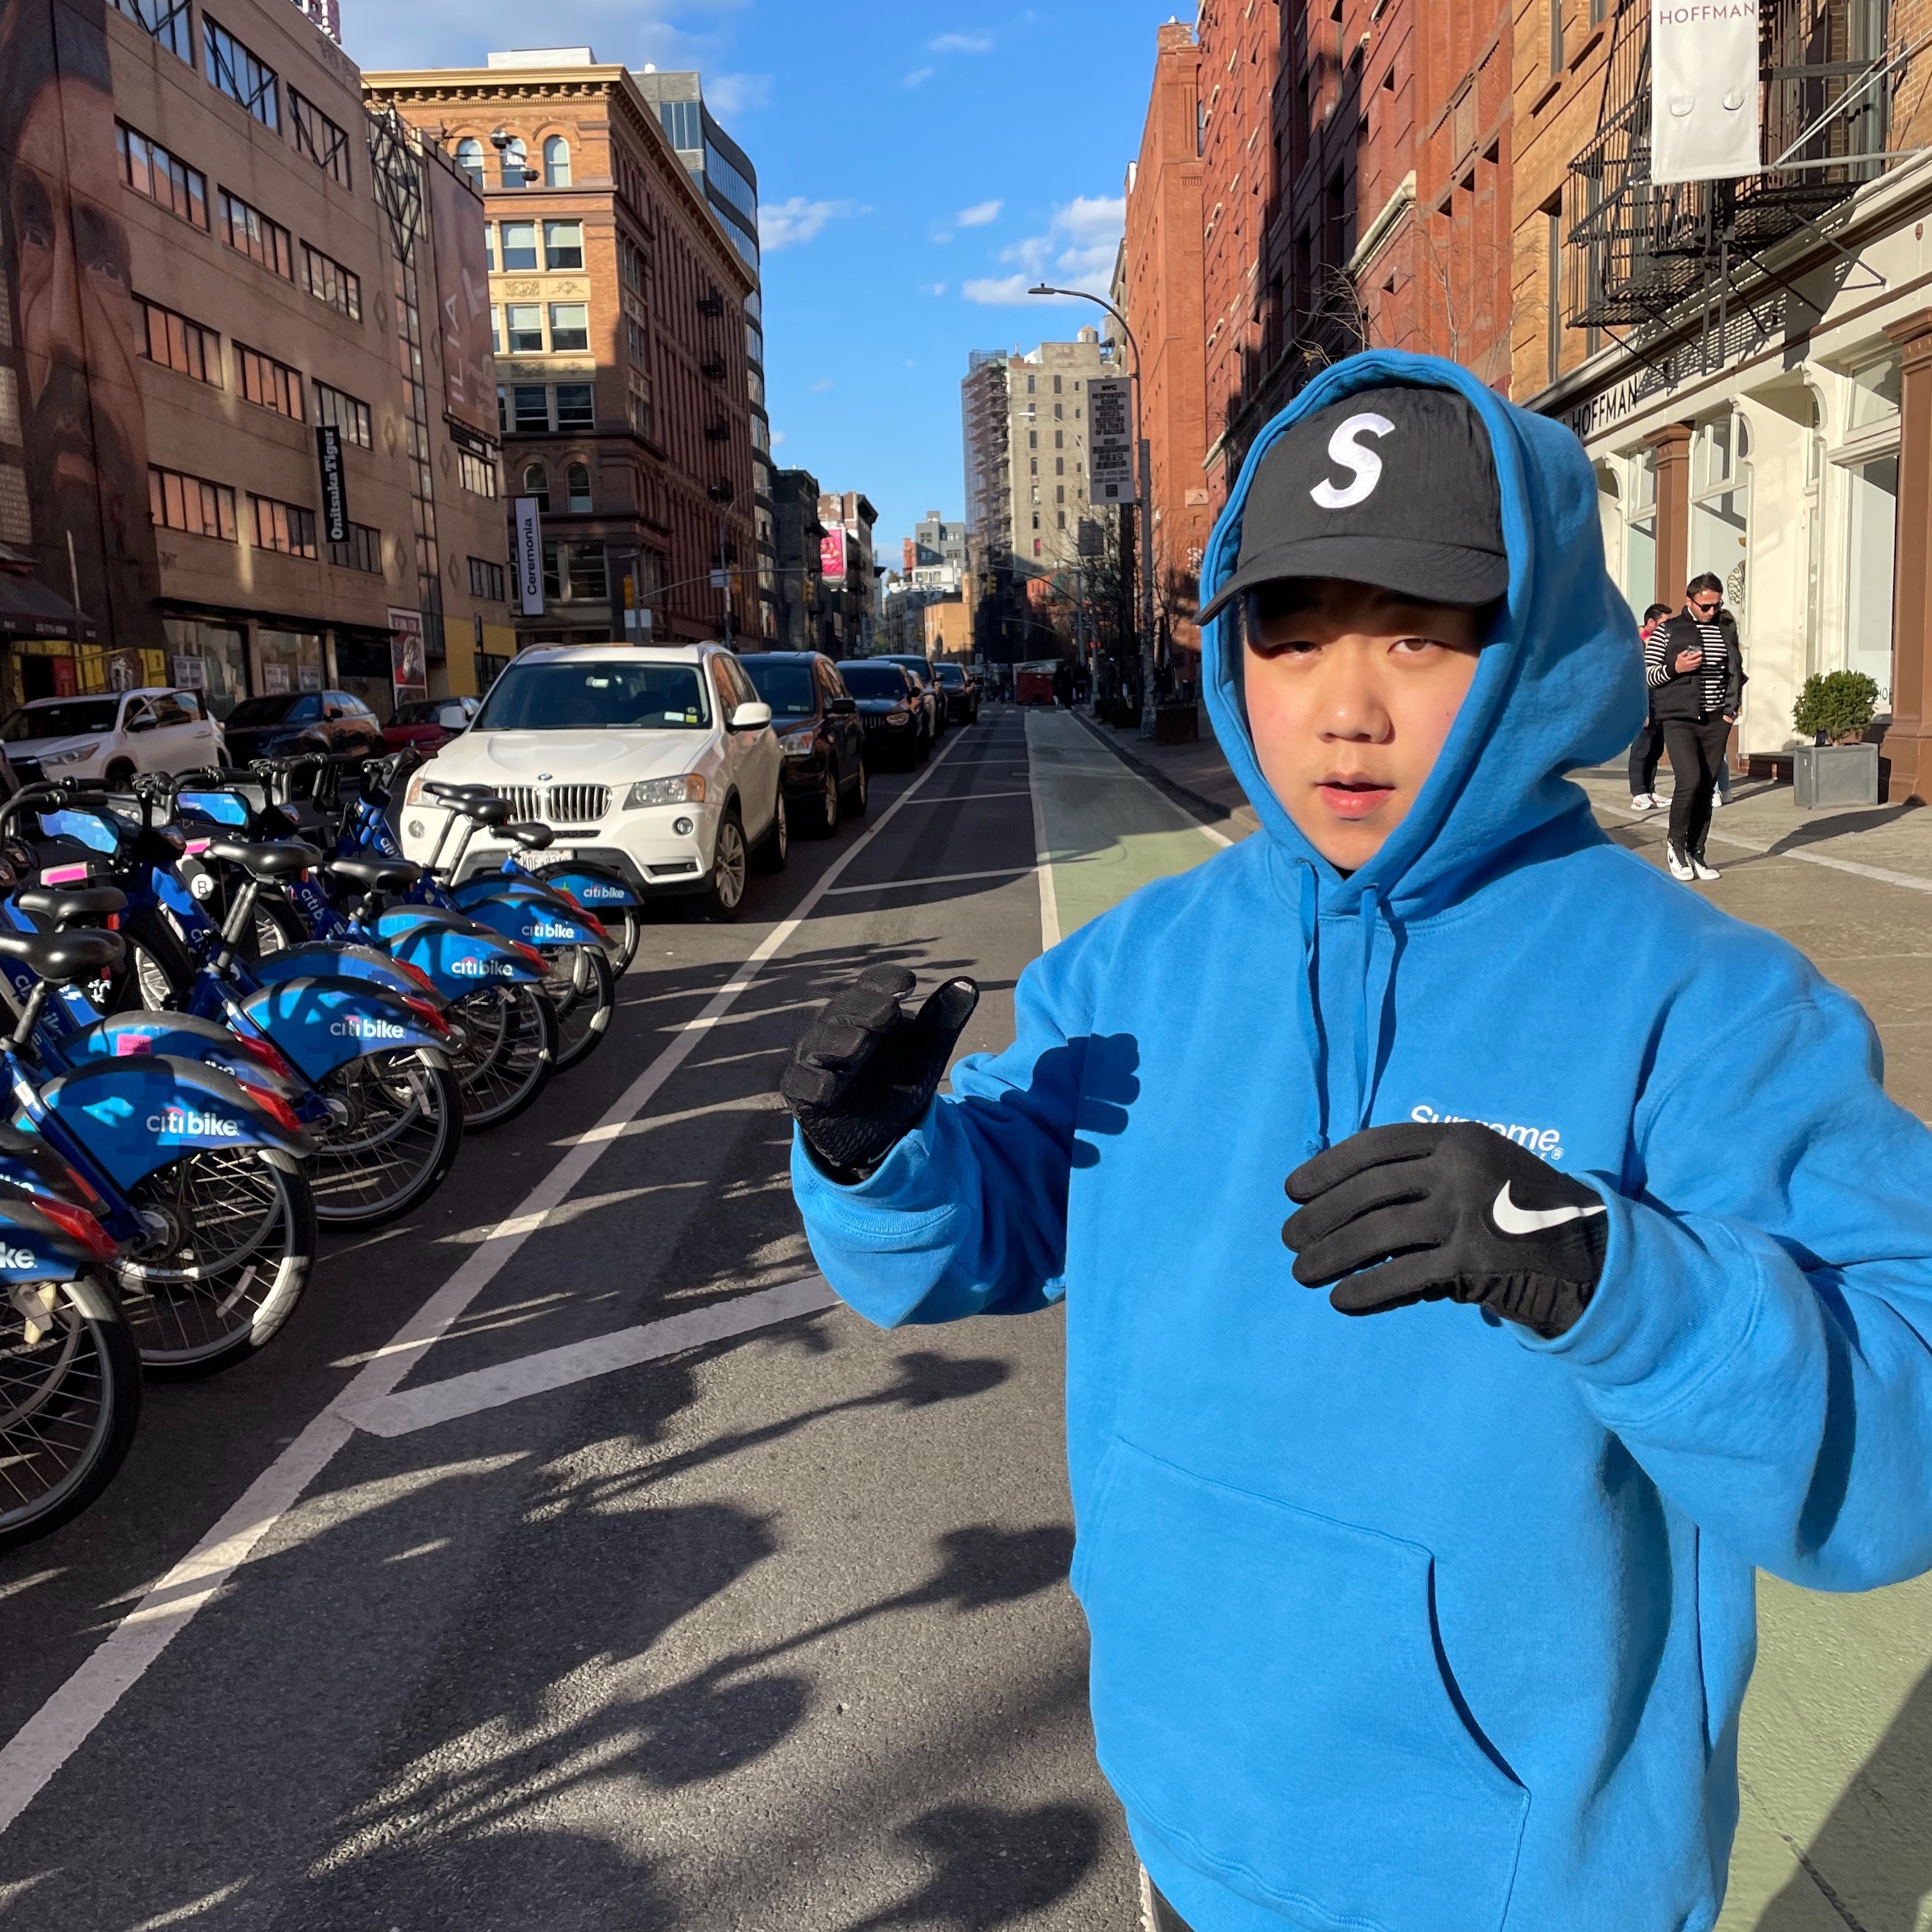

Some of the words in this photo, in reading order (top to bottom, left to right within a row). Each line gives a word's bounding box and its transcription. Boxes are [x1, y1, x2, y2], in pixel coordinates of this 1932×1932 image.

[1659, 2, 1755, 25] HOFFMAN
[1572, 374, 1637, 438] HOFFMAN
[325, 430, 339, 472] Tiger
[1310, 412, 1396, 509] S
[327, 471, 343, 540] Onitsuka
[523, 518, 537, 595] Ceremonia
[197, 880, 208, 894] B
[583, 885, 600, 898] citi
[602, 887, 624, 898] bike
[522, 922, 543, 937] citi
[546, 924, 574, 939] bike
[452, 956, 477, 975] citi
[479, 960, 514, 976] bike
[330, 1015, 360, 1036] citi
[363, 1020, 404, 1038] bike
[146, 1107, 184, 1133] citi
[188, 1112, 238, 1136] bike
